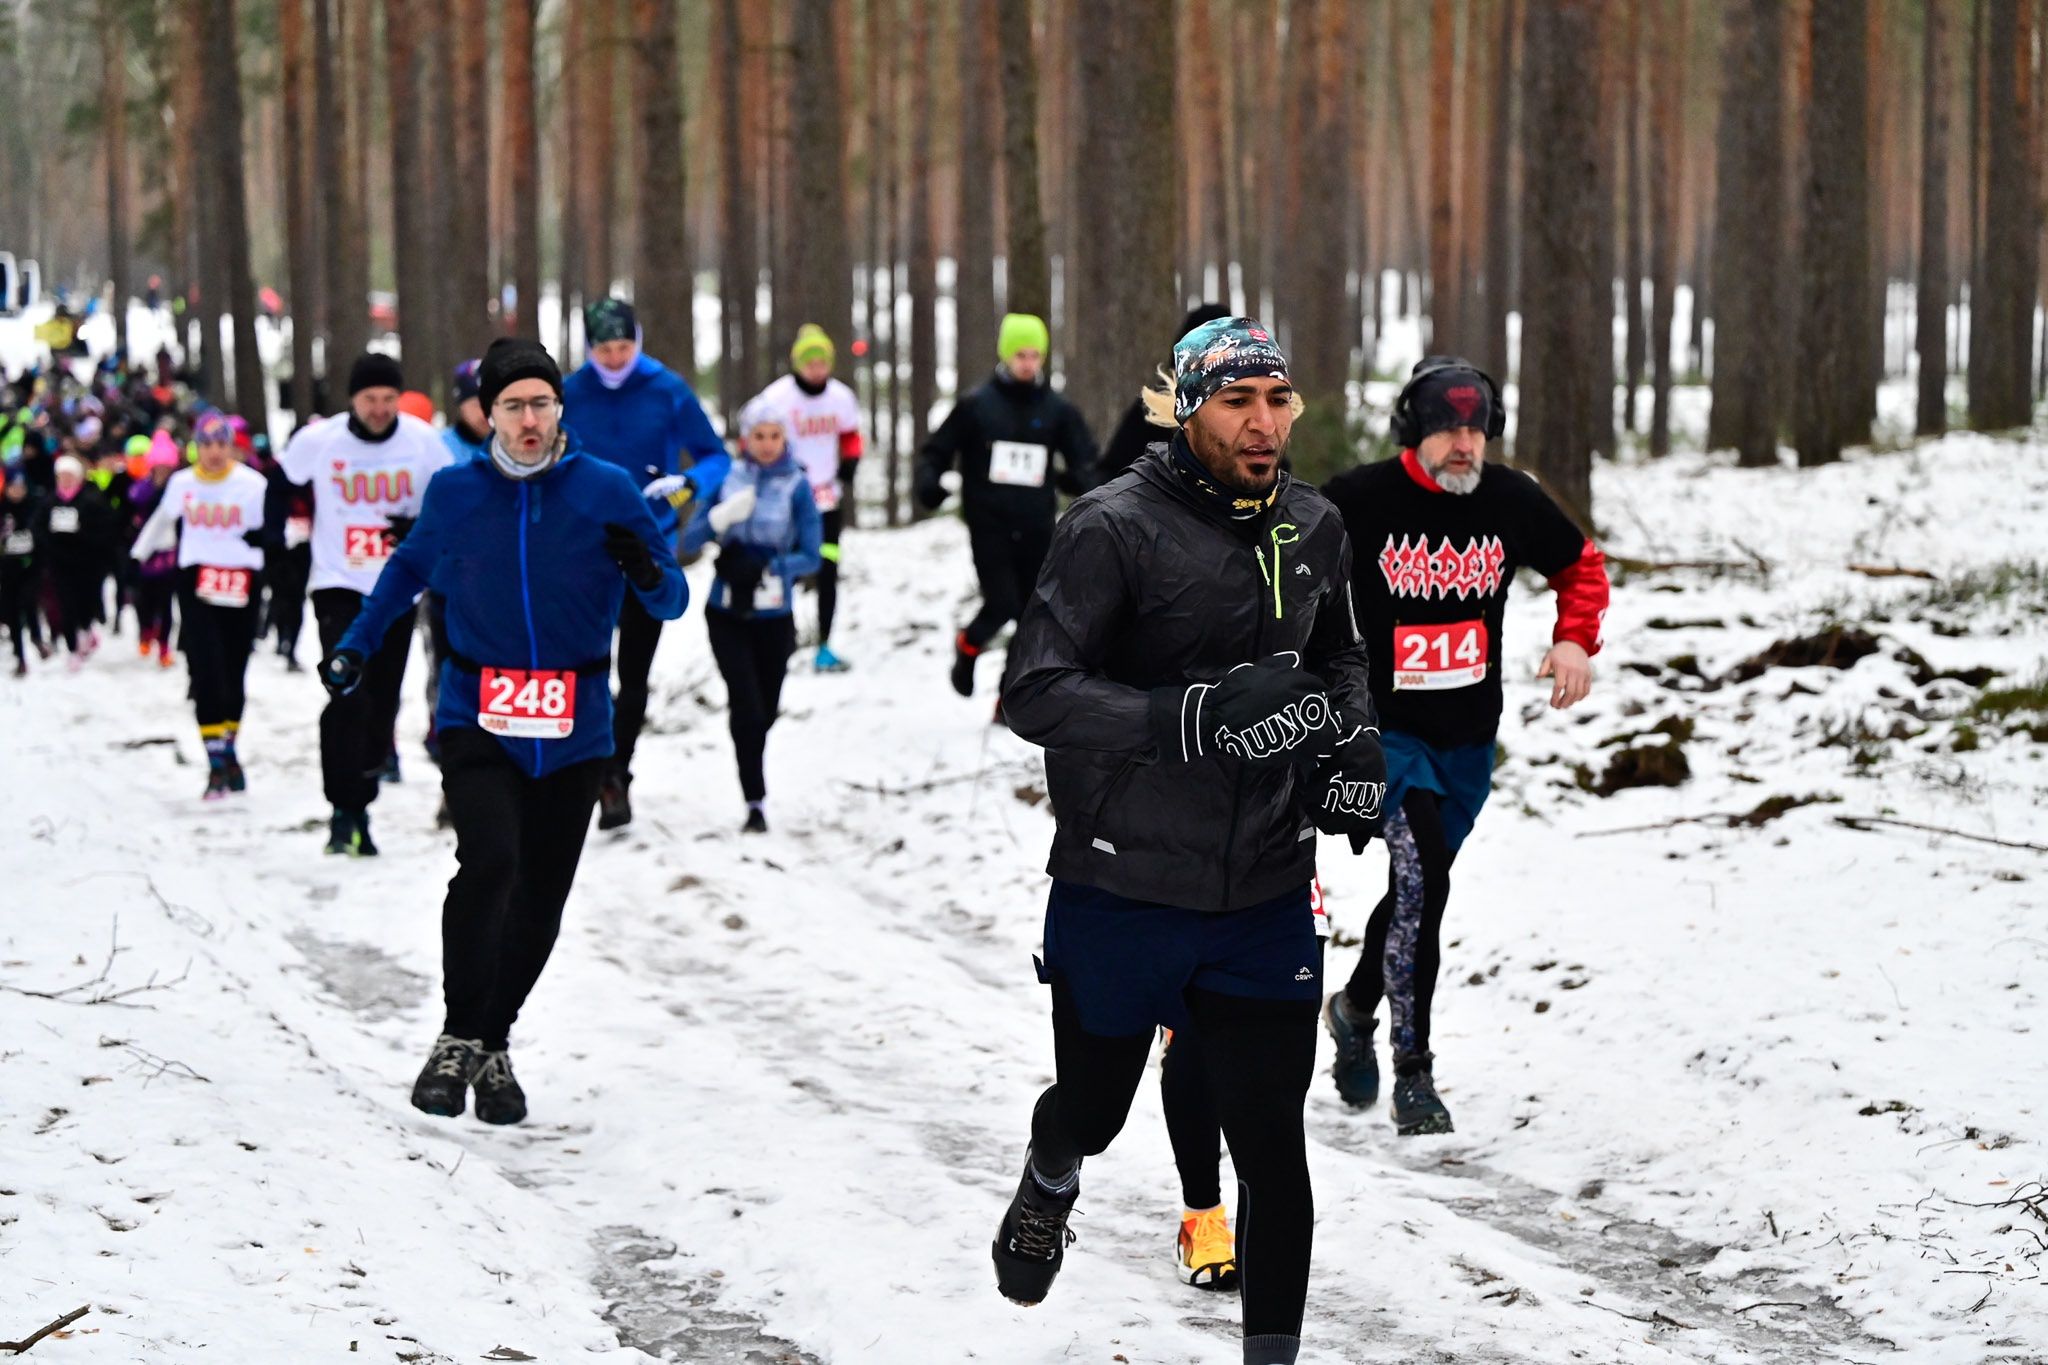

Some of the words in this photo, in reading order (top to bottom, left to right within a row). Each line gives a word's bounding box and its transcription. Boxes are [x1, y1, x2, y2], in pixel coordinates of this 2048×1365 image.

[1228, 348, 1258, 361] BIEG
[1378, 533, 1505, 601] VADER
[1402, 628, 1480, 670] 214
[487, 676, 567, 716] 248
